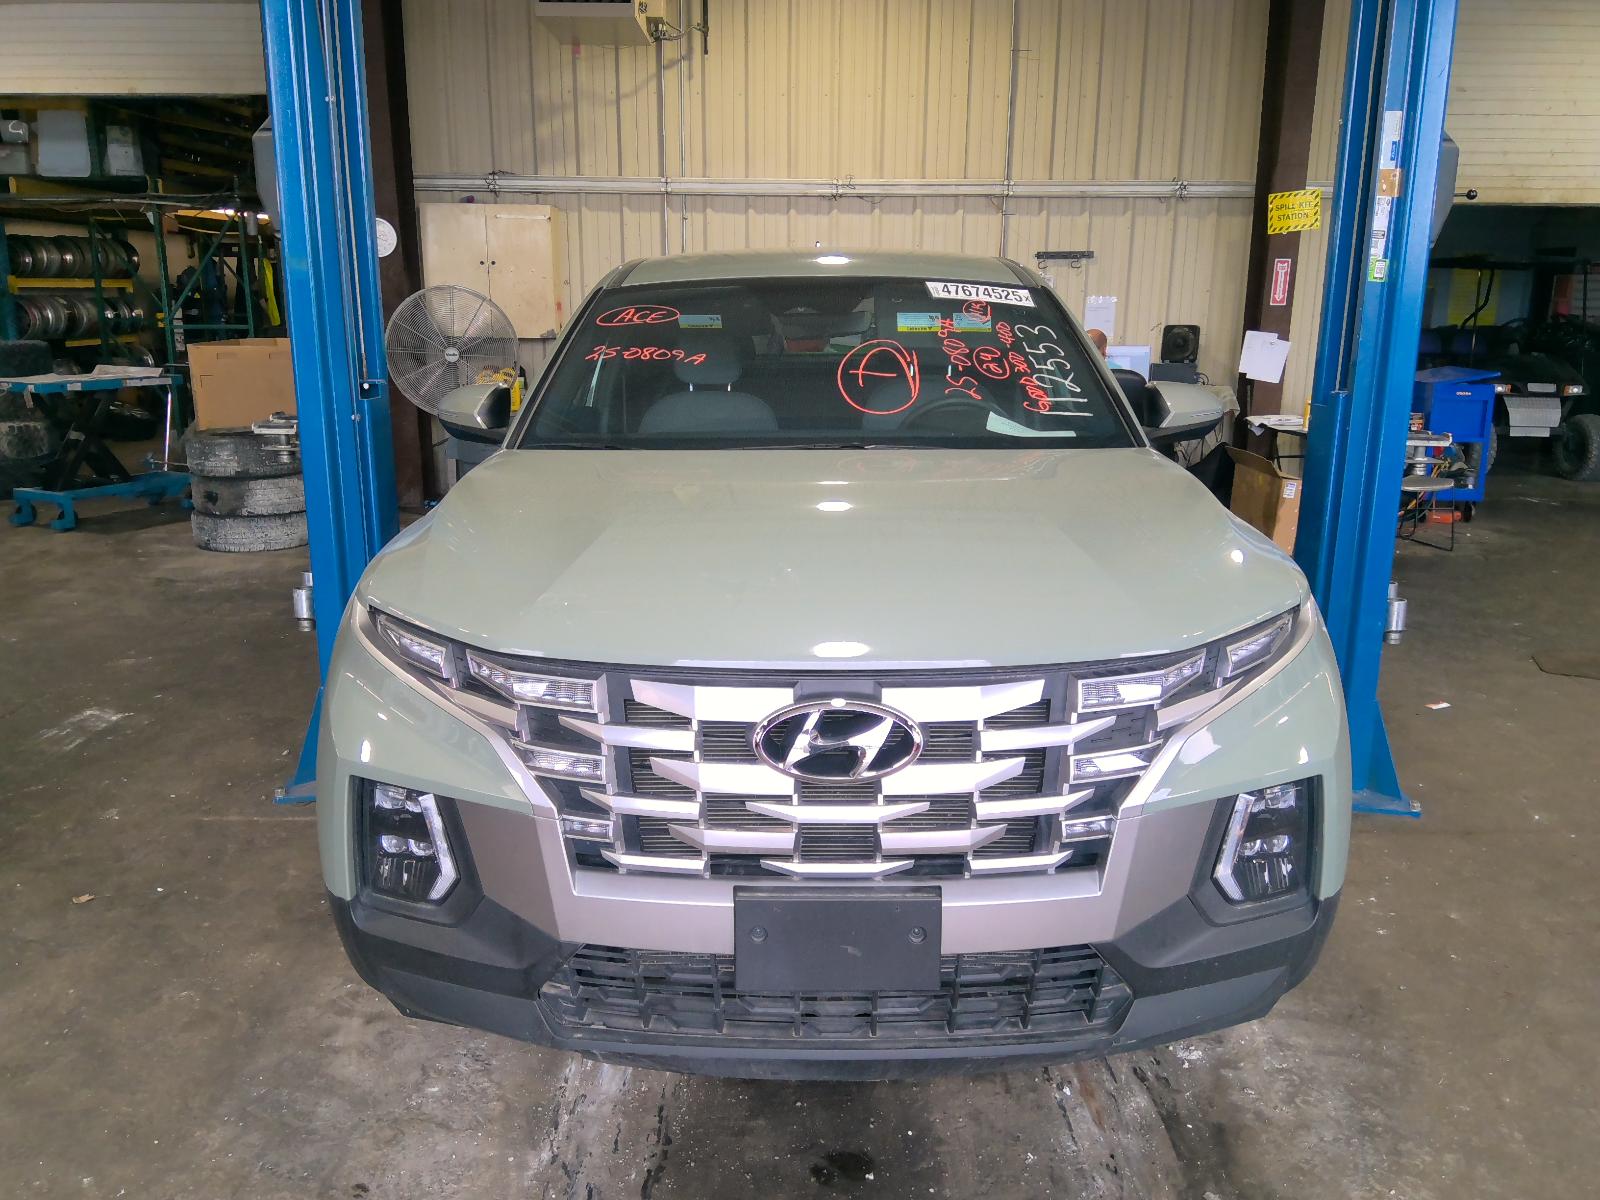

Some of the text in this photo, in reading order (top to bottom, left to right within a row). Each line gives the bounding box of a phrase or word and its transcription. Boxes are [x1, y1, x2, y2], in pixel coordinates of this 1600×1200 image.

[1277, 212, 1309, 222] STATION
[941, 283, 1022, 302] 47674525
[613, 308, 668, 323] ACE
